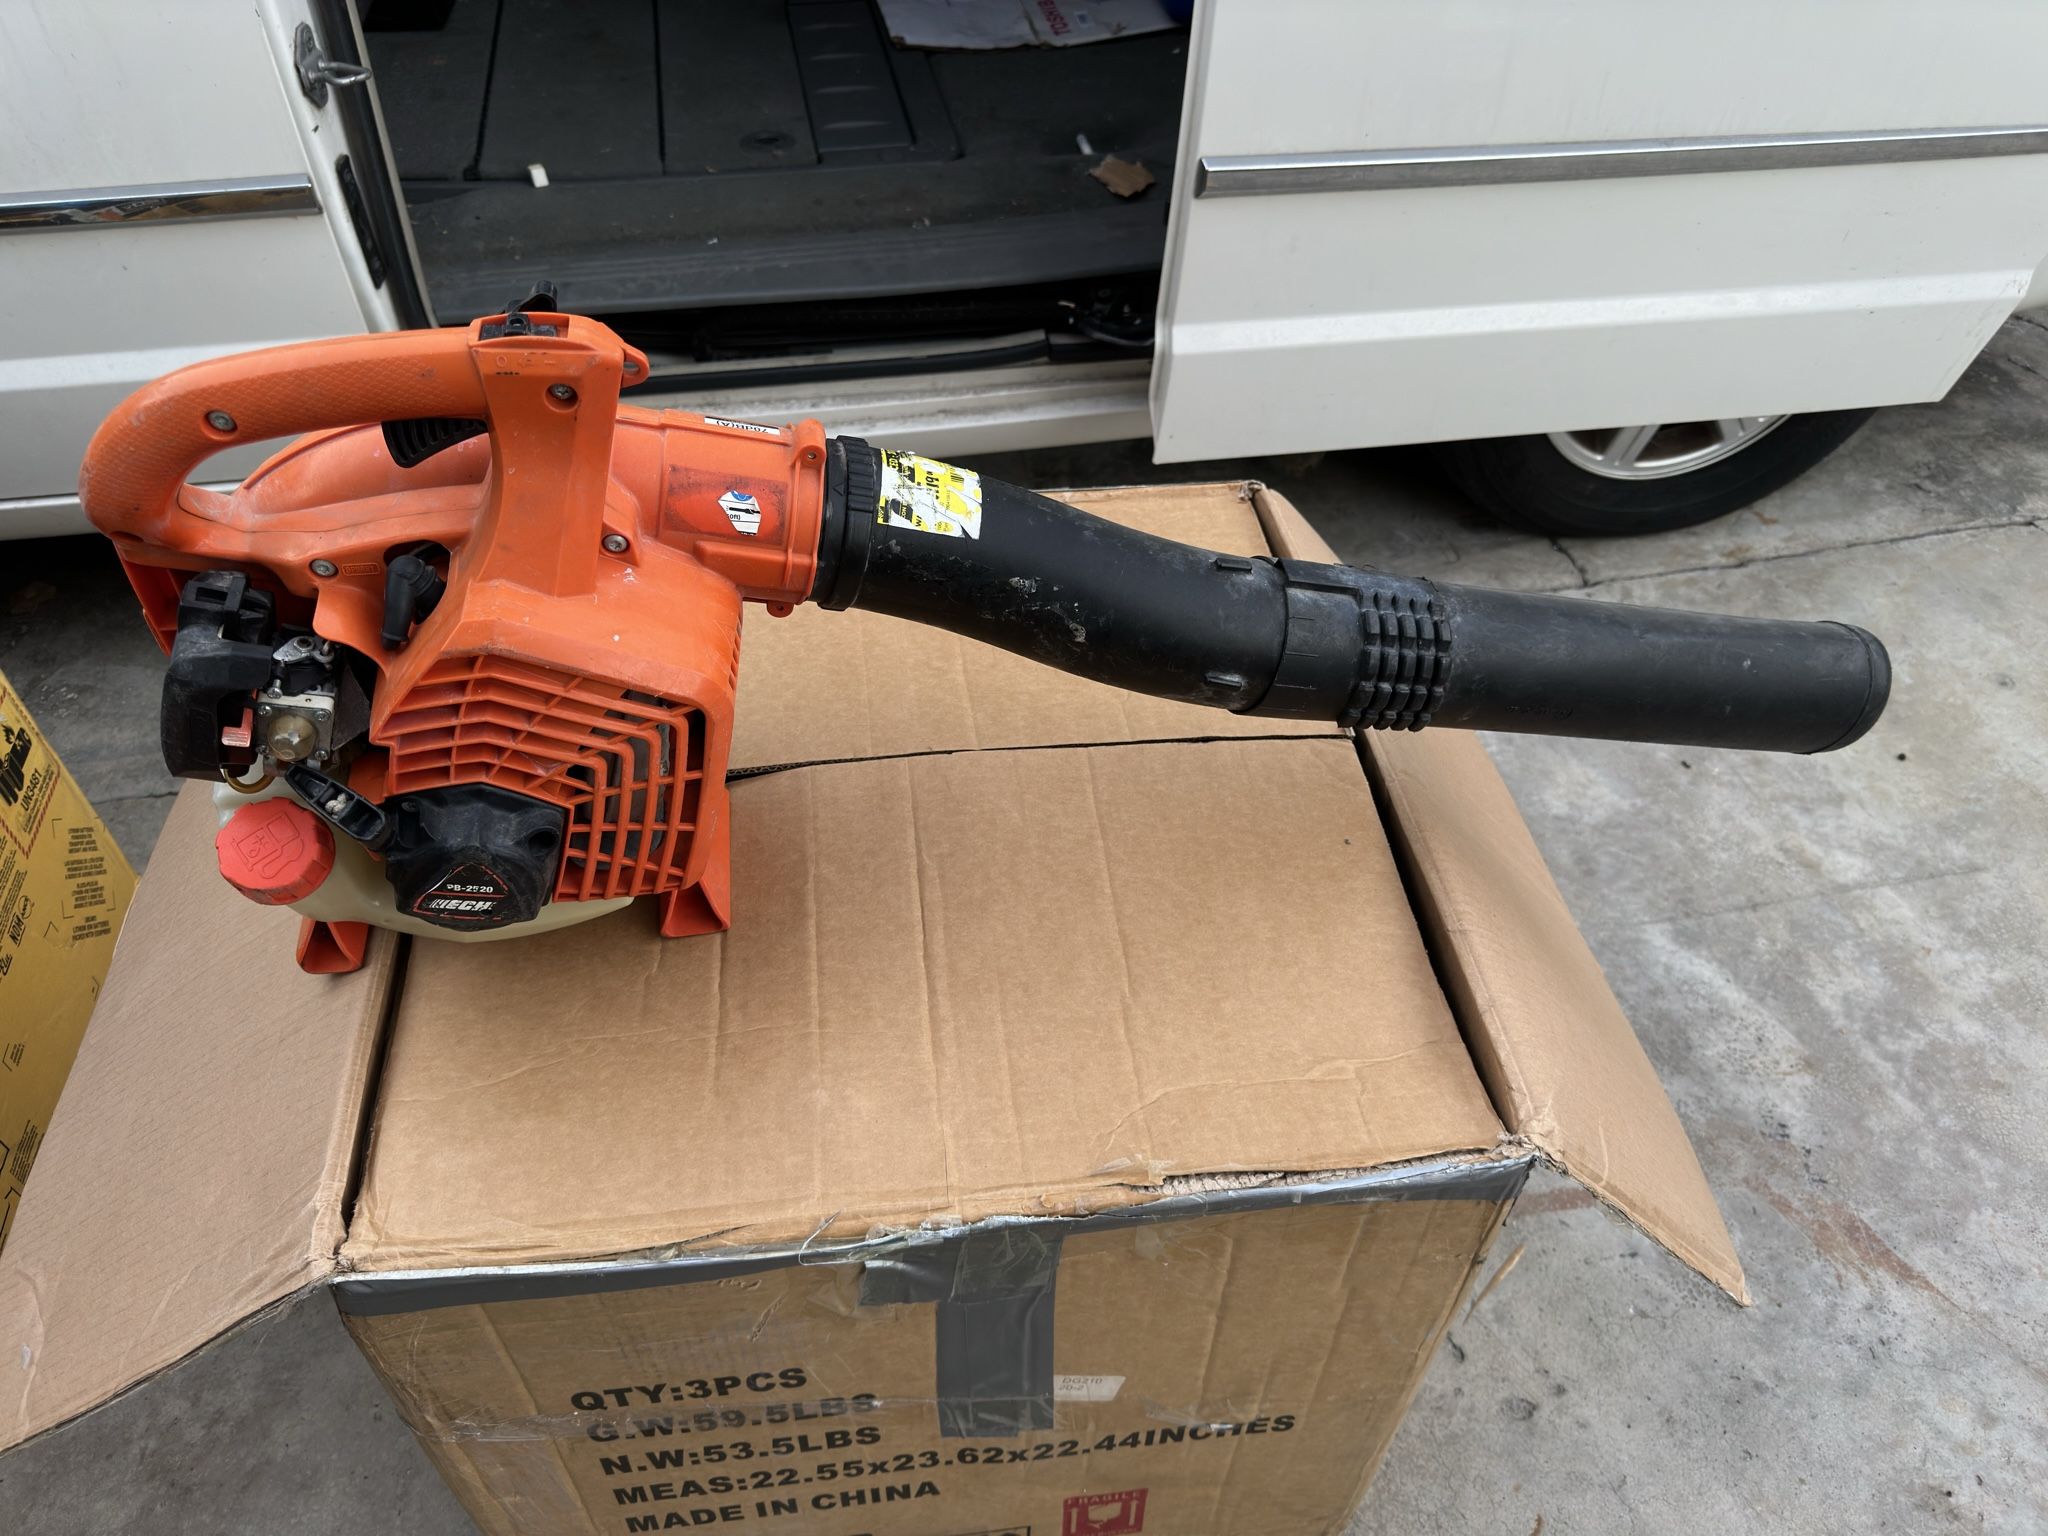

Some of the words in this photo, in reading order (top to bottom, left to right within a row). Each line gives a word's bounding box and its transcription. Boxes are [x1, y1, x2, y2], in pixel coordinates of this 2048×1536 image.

[20, 767, 43, 812] UN3481
[430, 898, 497, 912] ECH
[446, 883, 493, 893] PB-2520
[571, 1368, 807, 1410] QTY:3PCS
[587, 1393, 878, 1441] G.W:59.5LBS
[600, 1426, 881, 1475] N.W:53.5LBS
[613, 1415, 1295, 1505] MEAS:22.55x23.62x22.44INCHES
[625, 1504, 745, 1533] MADE
[755, 1498, 799, 1518] IN
[811, 1481, 941, 1510] CHINA
